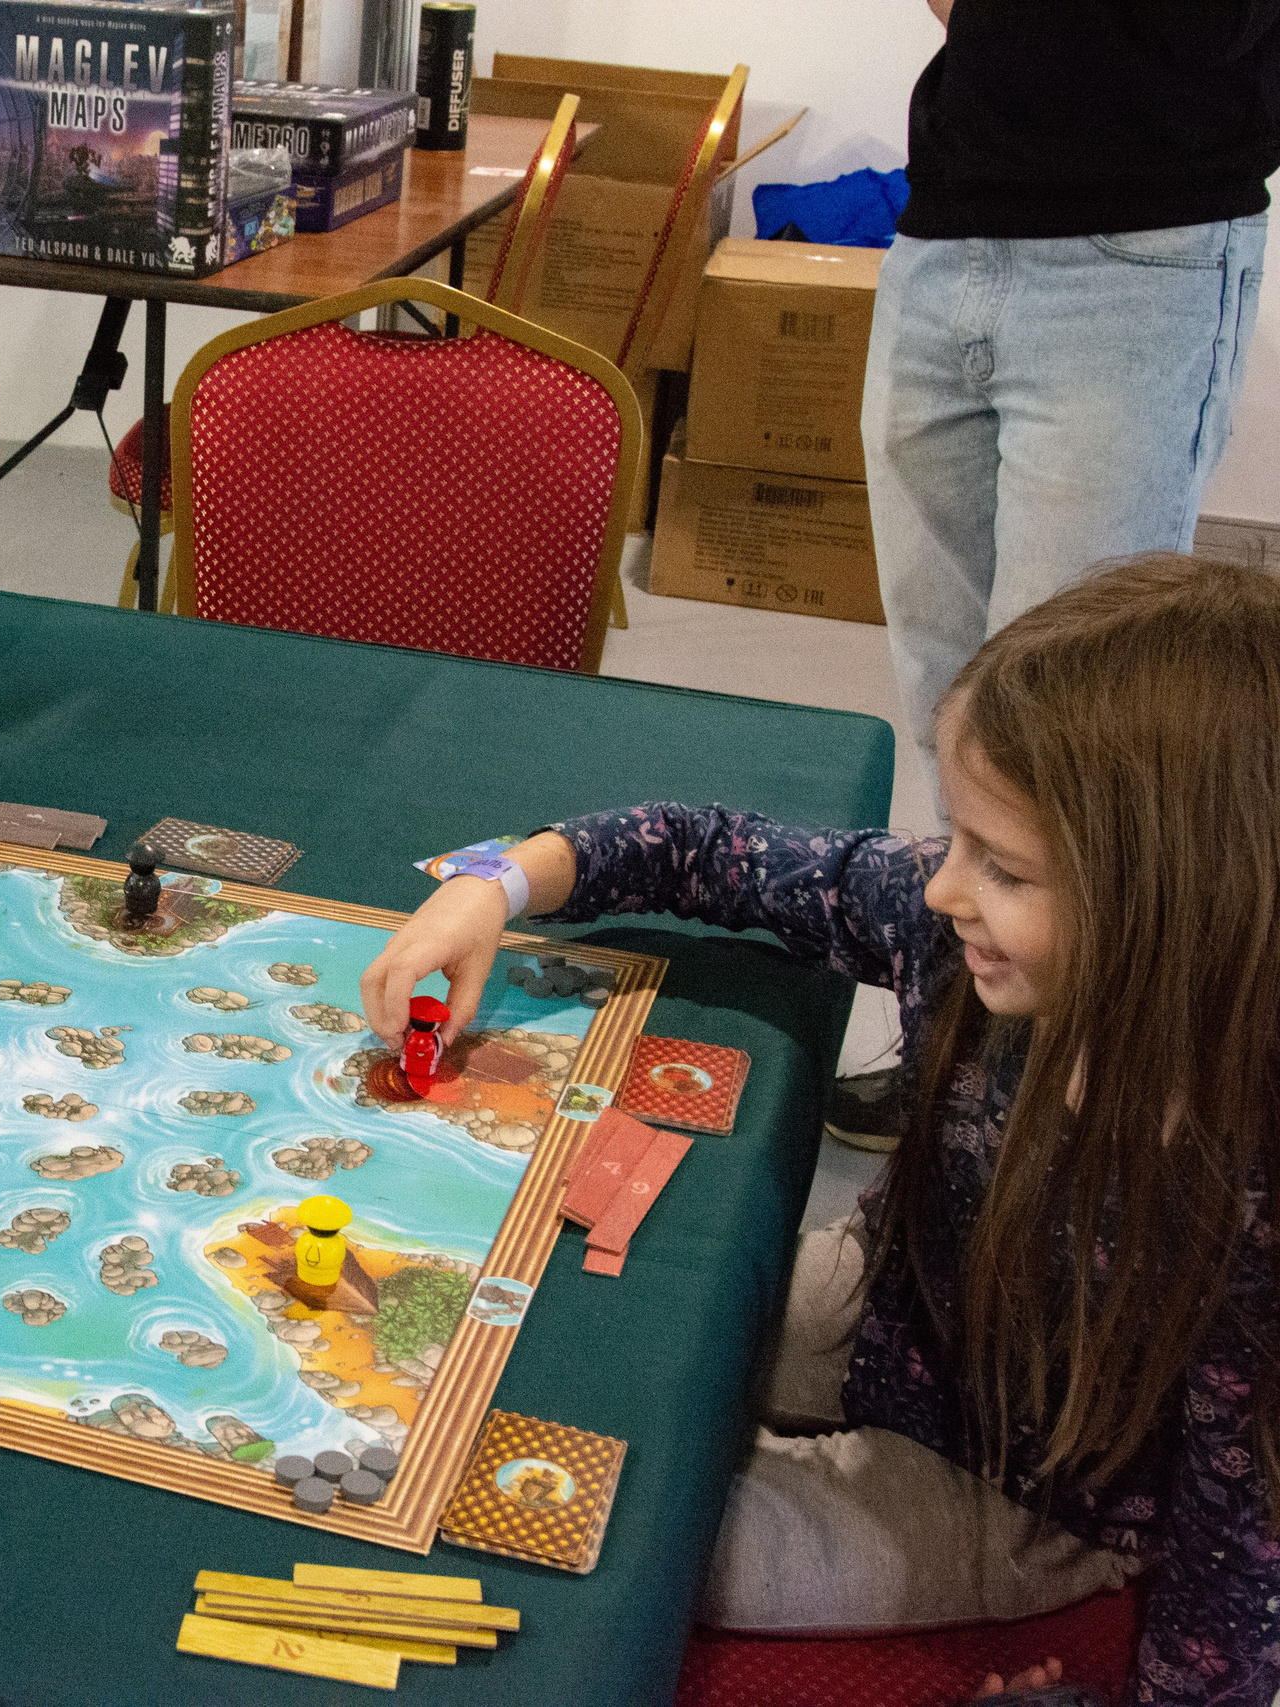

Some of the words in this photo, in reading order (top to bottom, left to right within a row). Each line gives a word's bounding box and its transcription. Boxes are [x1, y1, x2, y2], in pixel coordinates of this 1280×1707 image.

[15, 34, 168, 94] MAGLEV
[49, 90, 127, 133] MAPS
[448, 49, 465, 132] DIFFUSER
[232, 121, 310, 157] METRO
[39, 239, 89, 260] ALSPACH
